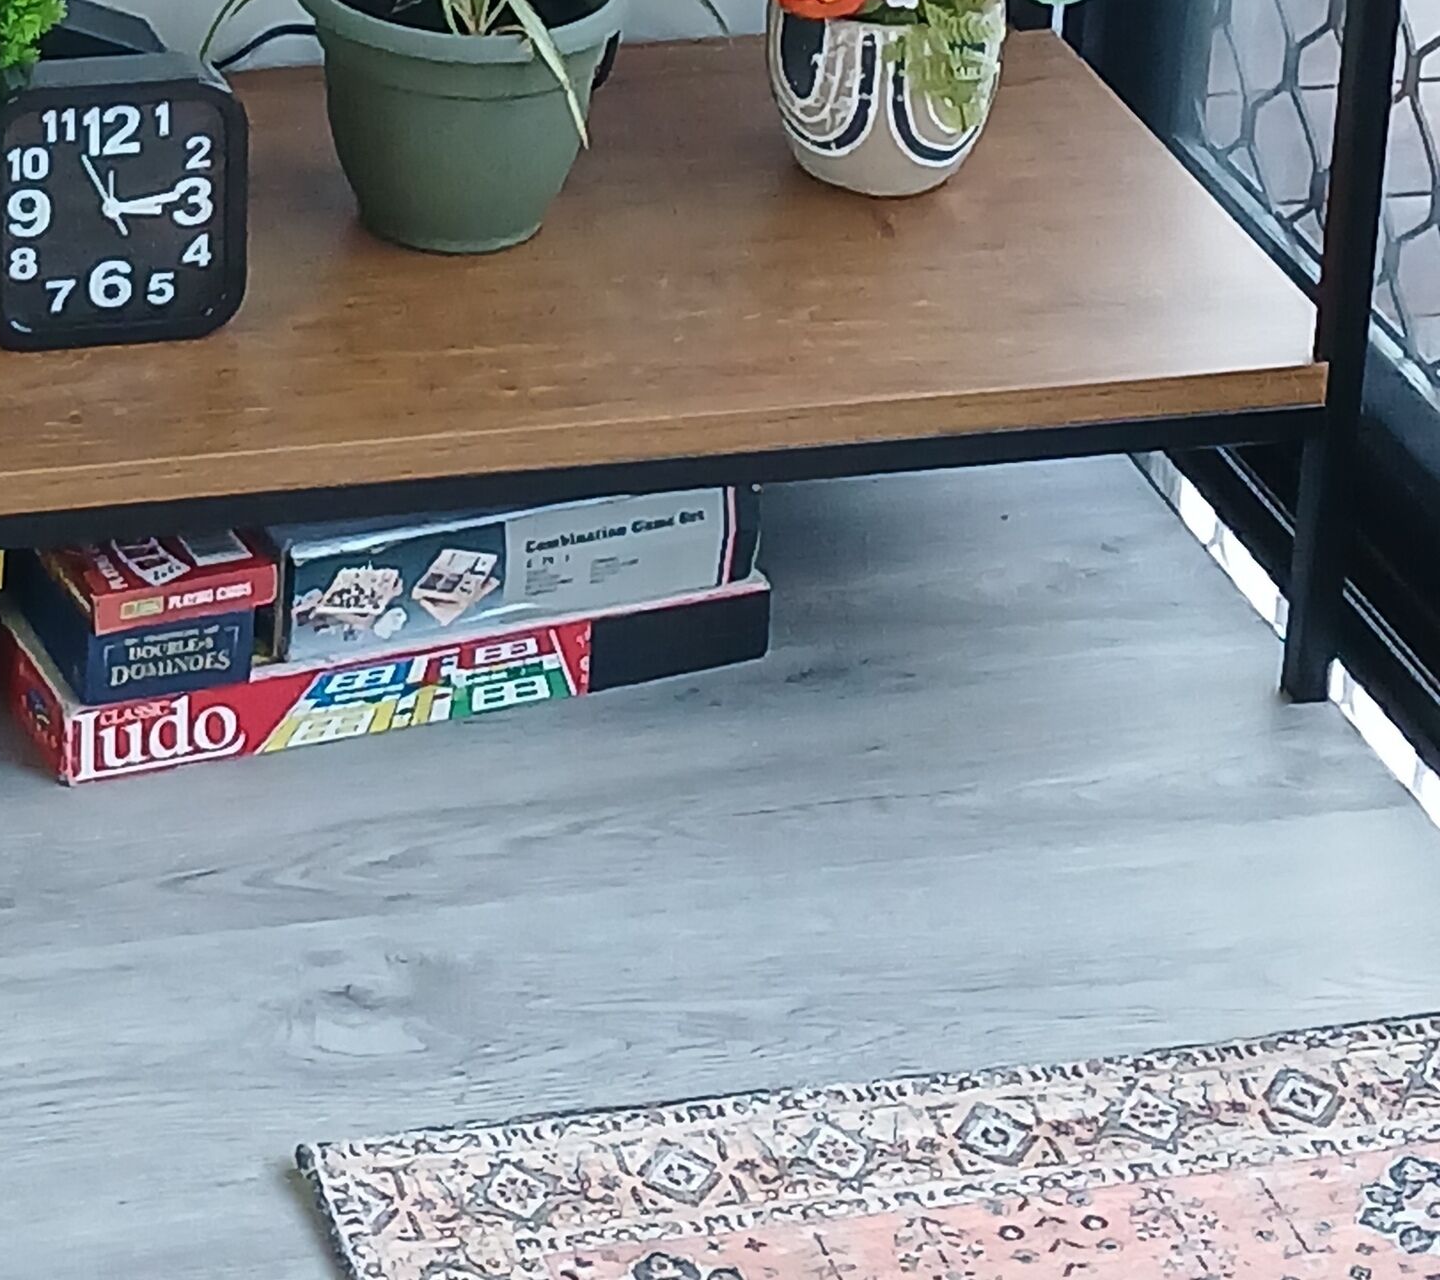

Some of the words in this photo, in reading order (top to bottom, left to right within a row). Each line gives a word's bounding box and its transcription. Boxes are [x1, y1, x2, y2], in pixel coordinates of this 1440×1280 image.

[42, 107, 76, 143] 11
[82, 105, 141, 157] 12
[155, 101, 170, 137] 1
[7, 147, 49, 182] 10
[185, 135, 212, 170] 2
[7, 188, 51, 238] 9
[172, 176, 213, 226] 3
[9, 247, 38, 281] 8
[181, 233, 212, 267] 4
[45, 279, 76, 313] 7
[89, 259, 132, 308] 6
[146, 272, 175, 305] 5
[525, 526, 626, 553] Combination
[632, 516, 674, 533] Game
[110, 649, 231, 686] DOMINOES
[100, 699, 172, 727] CLASSIC
